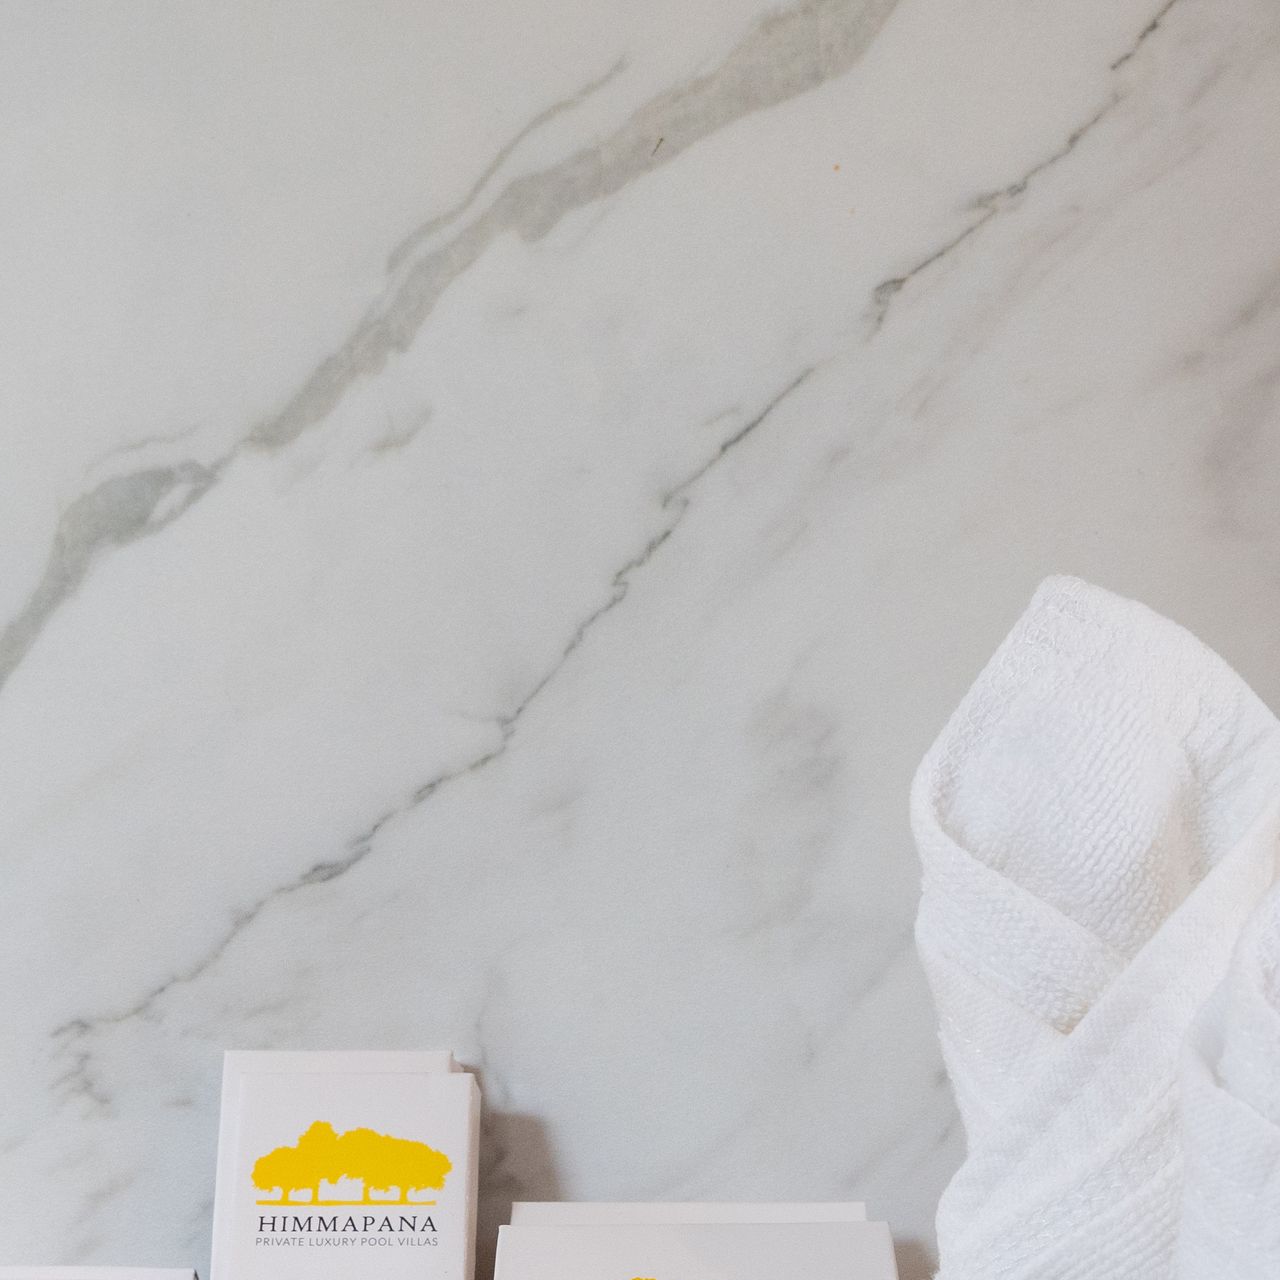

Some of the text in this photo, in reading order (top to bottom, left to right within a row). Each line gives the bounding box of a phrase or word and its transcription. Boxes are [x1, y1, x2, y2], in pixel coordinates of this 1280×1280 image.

[257, 1216, 439, 1233] HIMMAPANA
[255, 1237, 439, 1247] PRIVATE LUXURY POOL VILLAS
